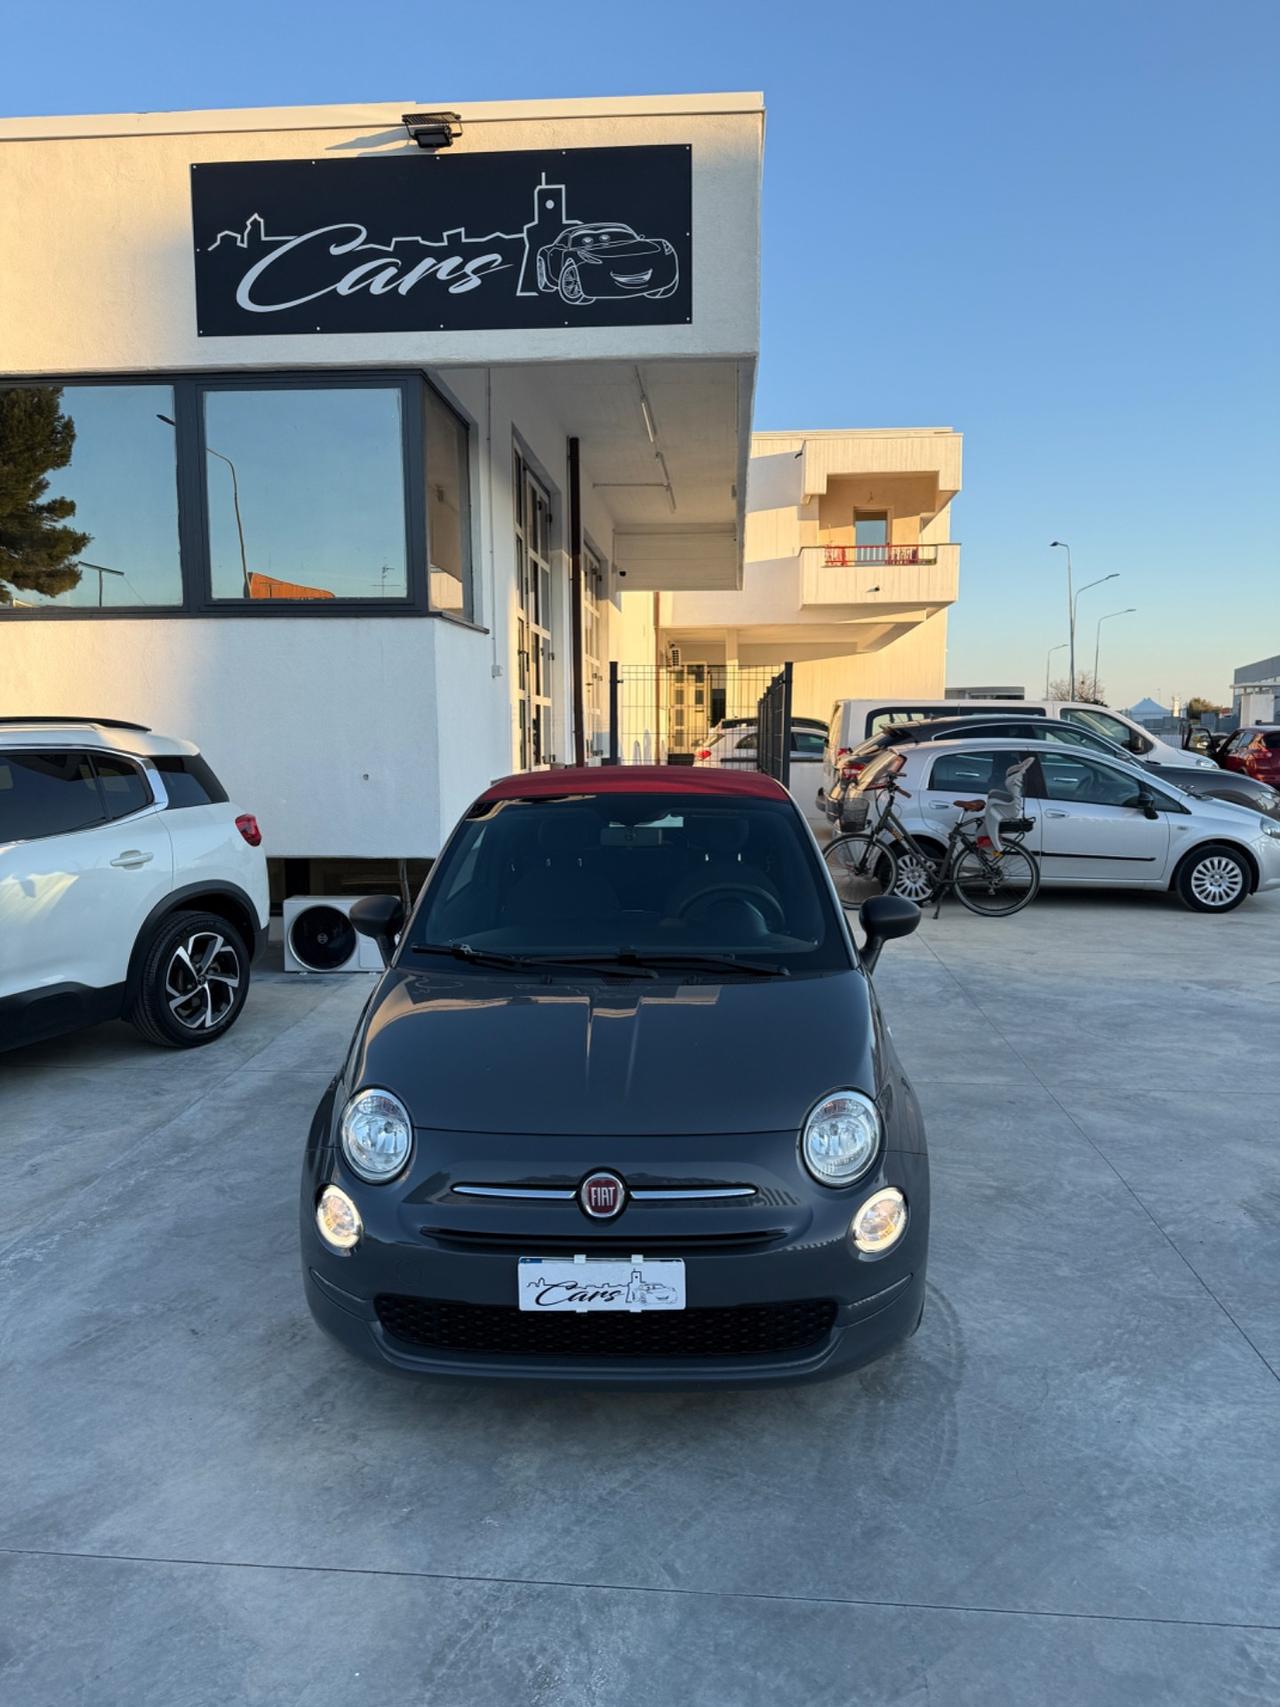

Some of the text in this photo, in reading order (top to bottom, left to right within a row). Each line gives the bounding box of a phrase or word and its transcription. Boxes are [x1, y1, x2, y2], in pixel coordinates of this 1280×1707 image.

[236, 223, 513, 312] Cars
[591, 1187, 616, 1206] FIAT
[535, 1281, 623, 1306] Cars
